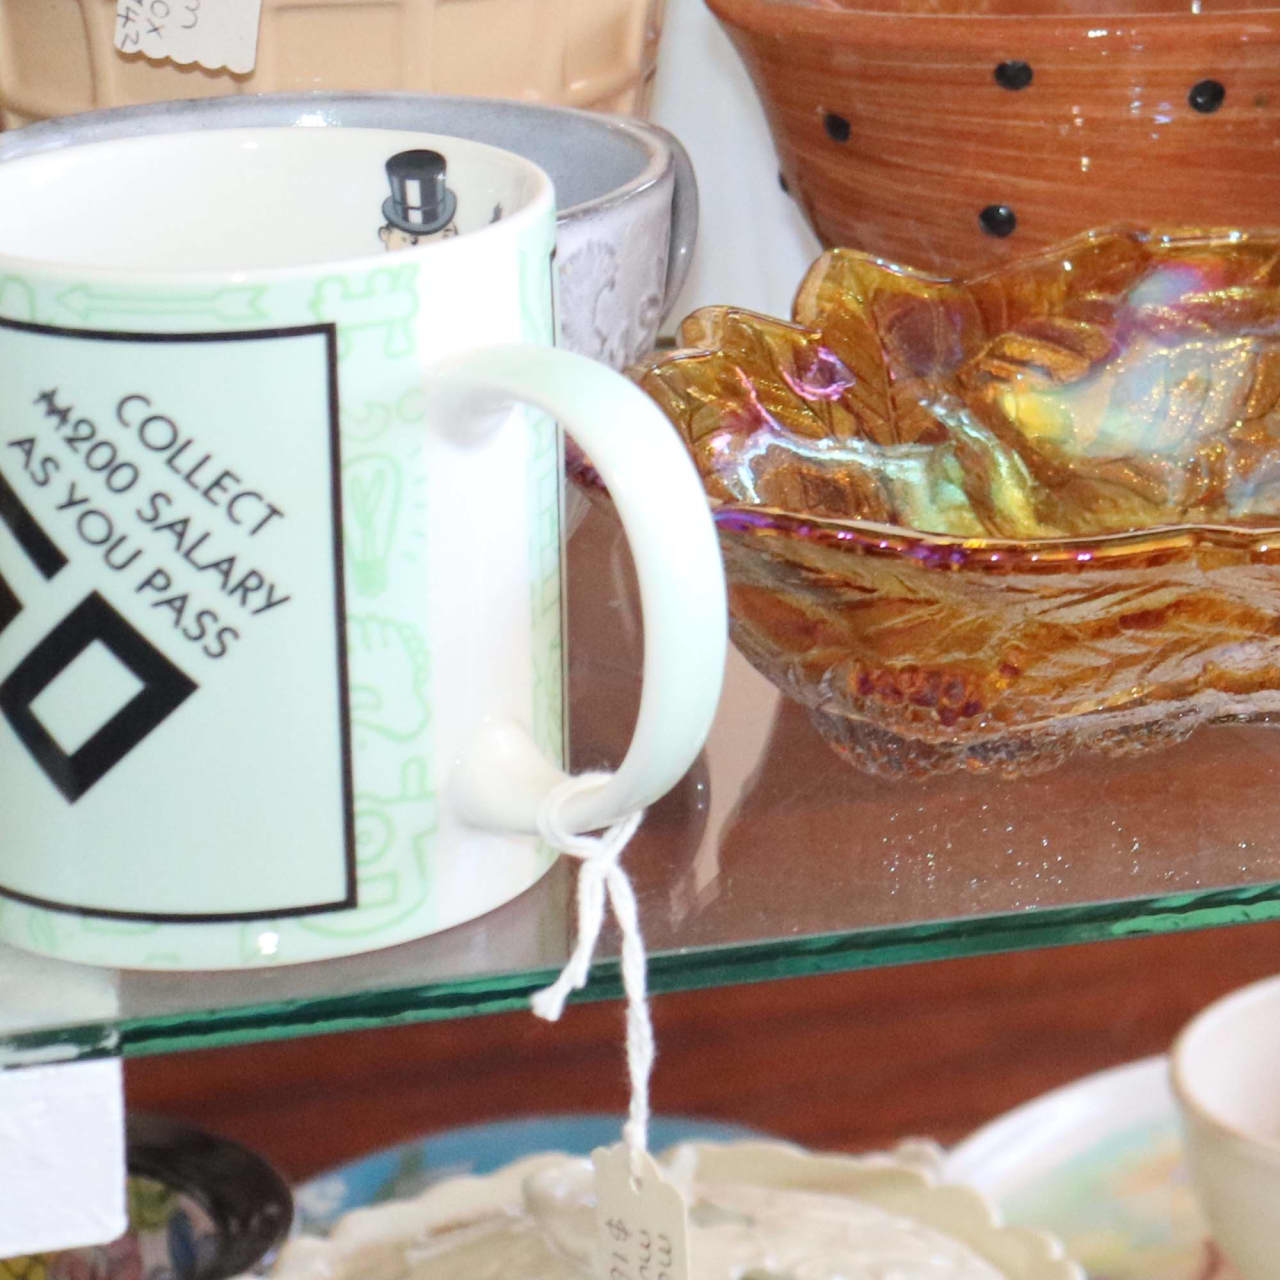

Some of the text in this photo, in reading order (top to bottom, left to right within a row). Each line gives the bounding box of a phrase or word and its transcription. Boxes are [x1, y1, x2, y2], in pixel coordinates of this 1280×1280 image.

[116, 393, 285, 536] COLLECT
[7, 437, 240, 659] AS YOU PASS
[136, 491, 291, 615] SALARY
